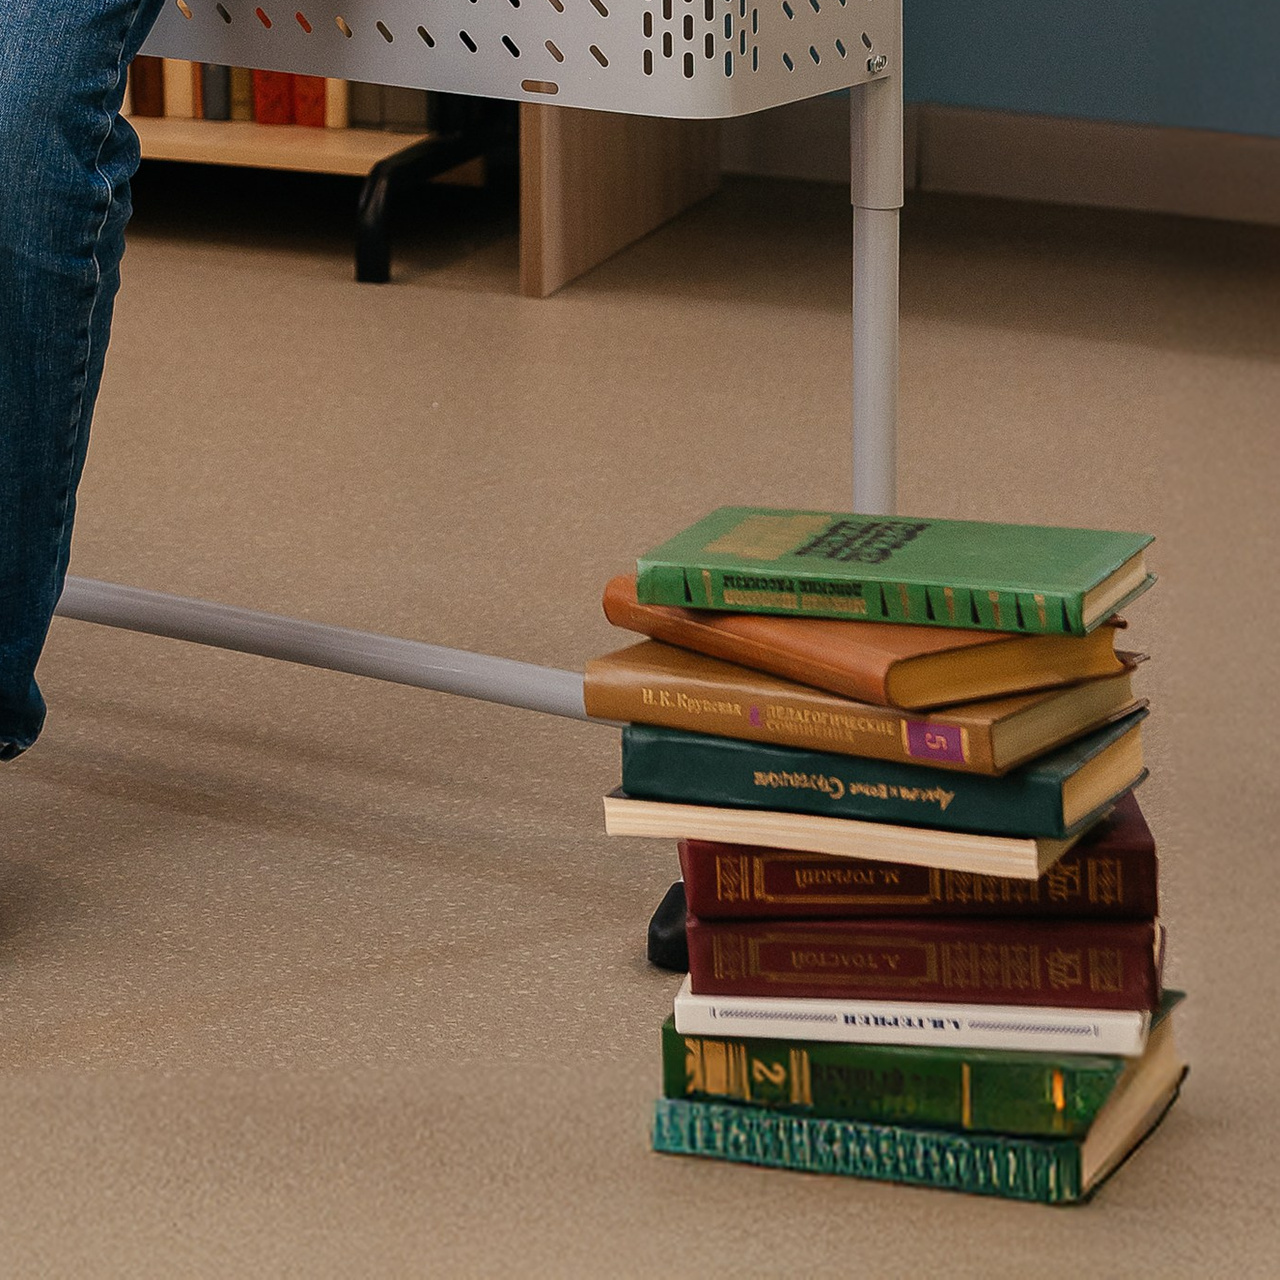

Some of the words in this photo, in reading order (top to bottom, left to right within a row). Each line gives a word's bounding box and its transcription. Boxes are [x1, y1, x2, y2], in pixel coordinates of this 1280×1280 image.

[676, 690, 743, 718] Крупская
[924, 732, 949, 751] 5
[794, 867, 874, 888] ГОРЬКИЙ
[882, 869, 900, 885] М.
[791, 950, 875, 969] ТОЛСТОЙ
[751, 1057, 786, 1084] 2
